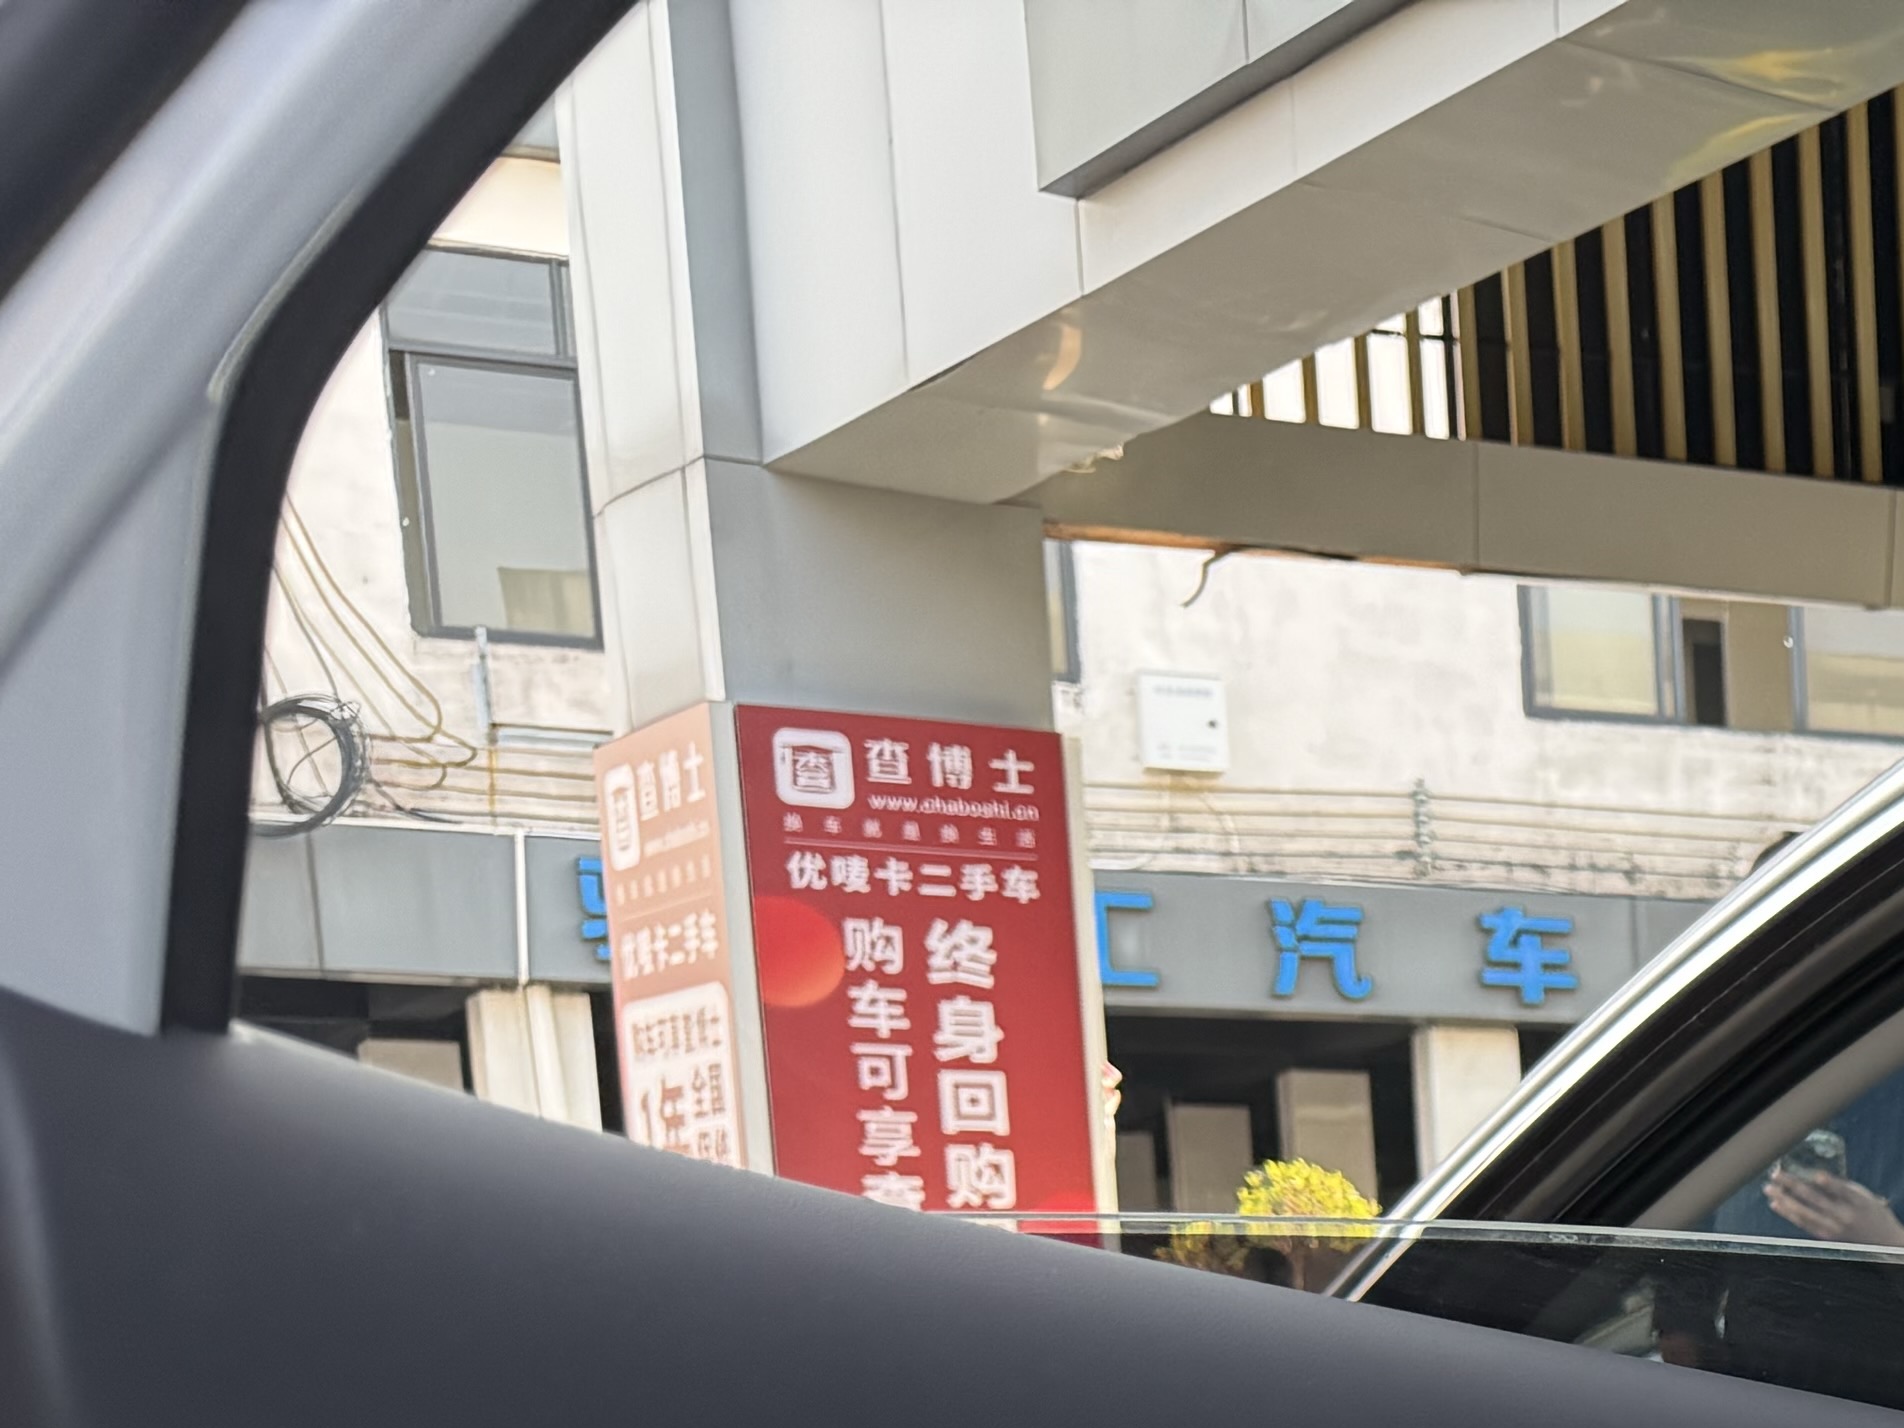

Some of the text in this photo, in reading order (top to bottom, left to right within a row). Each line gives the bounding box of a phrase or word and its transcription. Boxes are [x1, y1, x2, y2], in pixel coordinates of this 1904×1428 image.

[864, 738, 1036, 795] 查博士
[785, 850, 1041, 904] 优唛卡二手车
[923, 917, 1017, 1210] 终身回购
